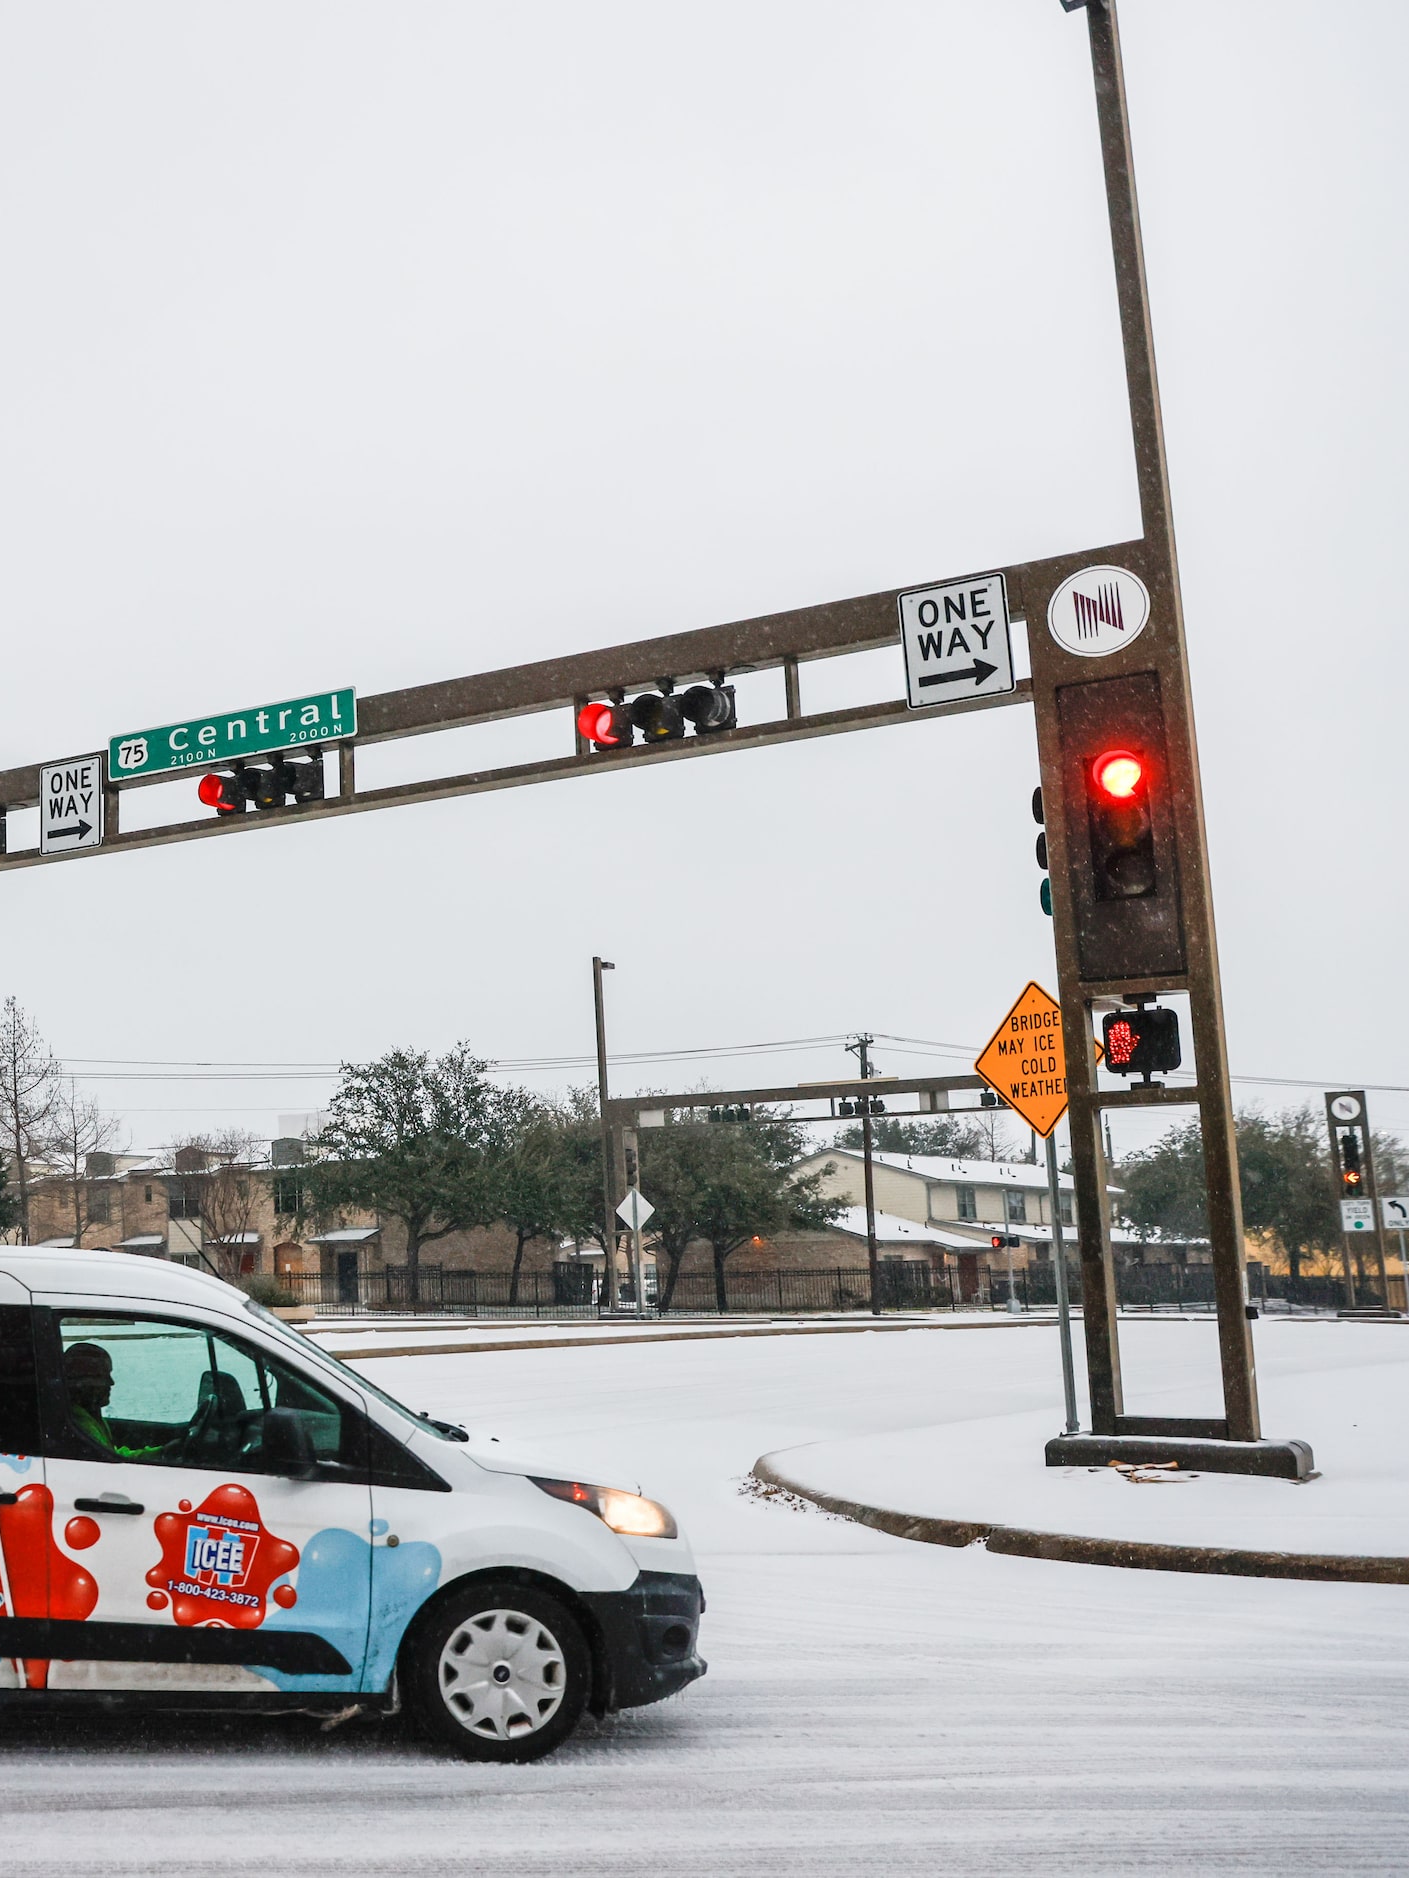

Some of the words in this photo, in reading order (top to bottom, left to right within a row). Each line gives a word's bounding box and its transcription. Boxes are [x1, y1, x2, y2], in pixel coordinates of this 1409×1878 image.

[918, 588, 991, 628] ONE
[917, 620, 995, 661] WAY
[120, 744, 144, 765] 75
[168, 694, 342, 750] Central
[289, 726, 329, 742] 2000
[333, 723, 342, 733] N
[170, 750, 204, 765] 2100
[207, 748, 217, 758] N
[50, 766, 92, 794] ONE
[49, 791, 94, 819] WAY
[1011, 1010, 1060, 1032] BRIDGE
[998, 1038, 1024, 1056] MAY
[1034, 1034, 1055, 1051] ICE
[1021, 1056, 1056, 1075] COLD
[192, 1538, 245, 1574] ICEE
[168, 1580, 260, 1608] 1-800-423-3872
